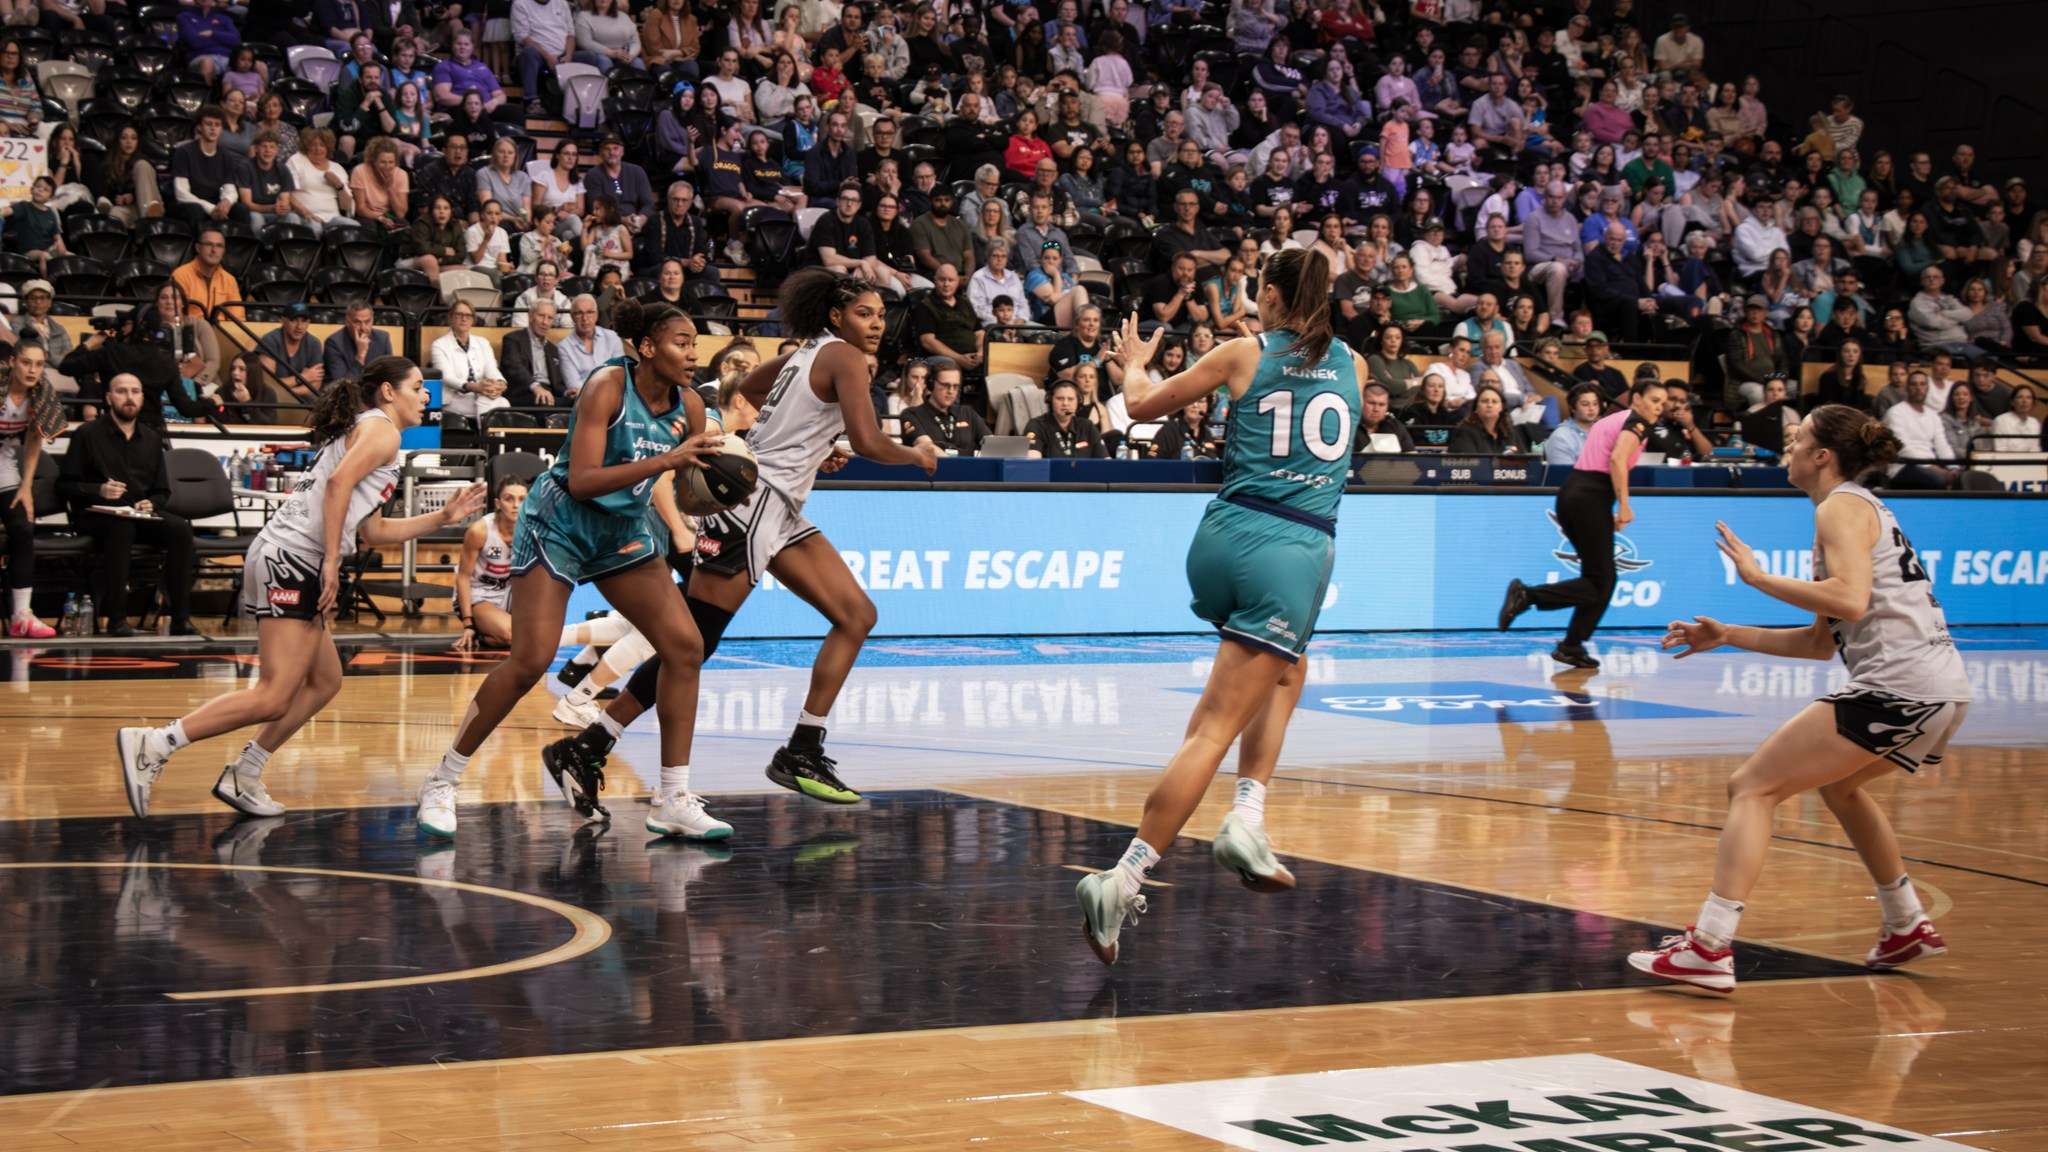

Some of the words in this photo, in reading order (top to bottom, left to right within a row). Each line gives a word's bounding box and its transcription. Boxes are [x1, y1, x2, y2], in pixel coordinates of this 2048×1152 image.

[3, 140, 29, 160] 22
[1258, 390, 1351, 462] 10
[1450, 469, 1472, 479] SUB
[1493, 469, 1527, 480] BONUS
[838, 550, 950, 589] REAT
[964, 550, 1124, 589] ESCAPE
[270, 591, 298, 602] AAMI
[1224, 1087, 1728, 1146] McKAY
